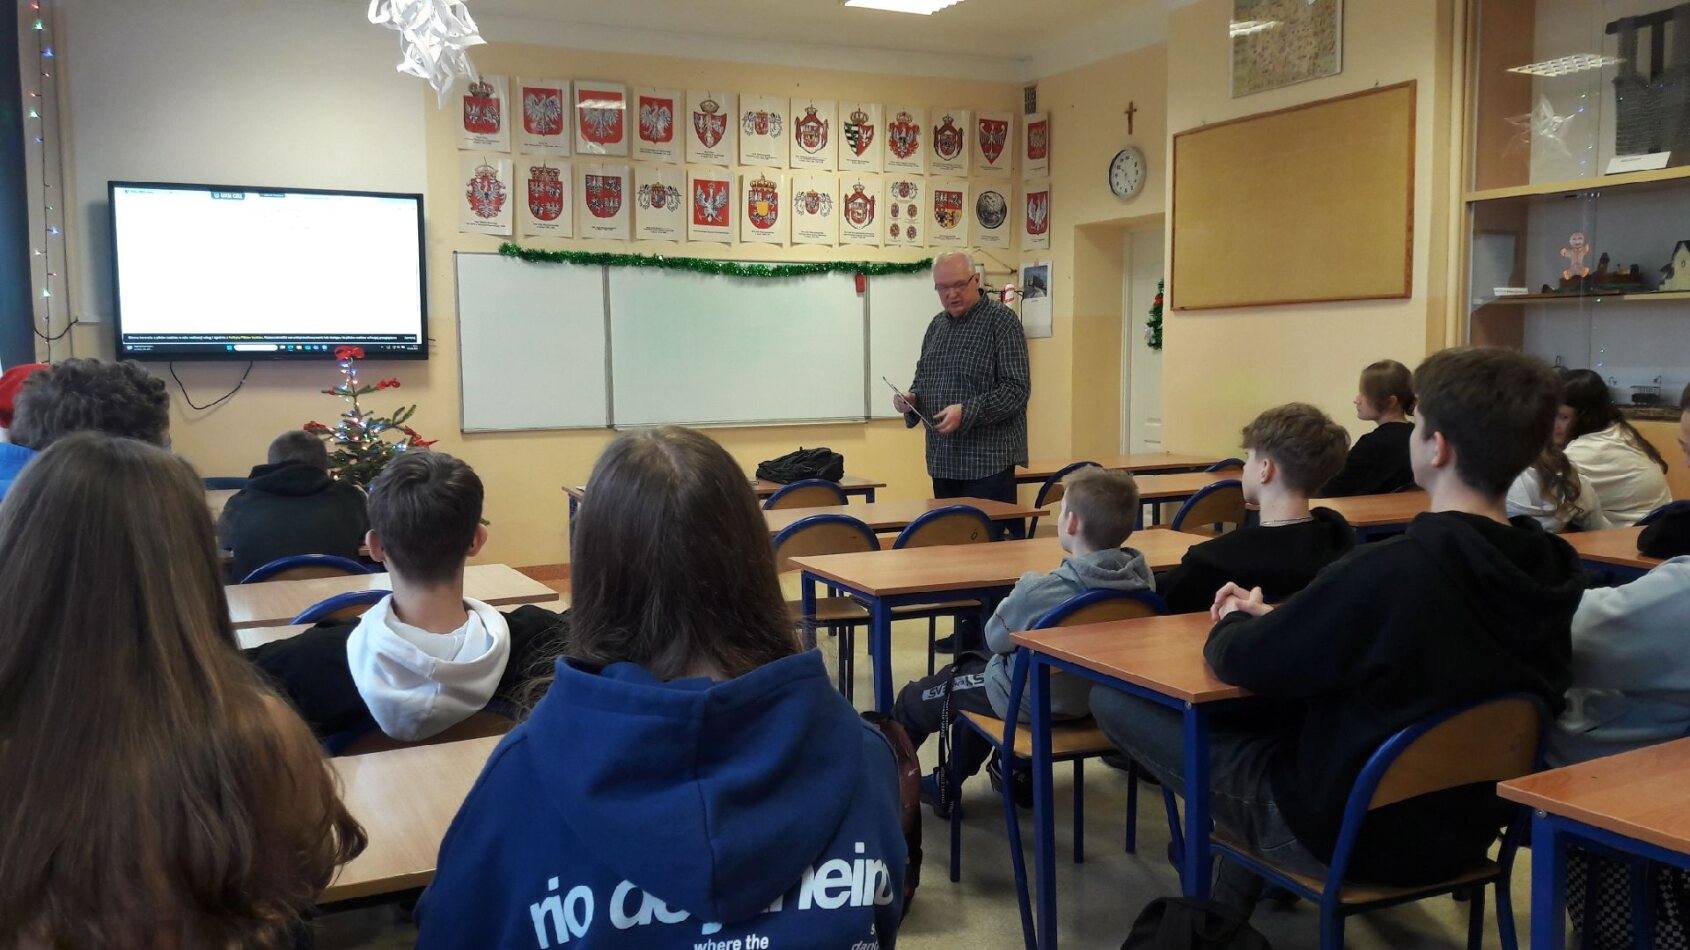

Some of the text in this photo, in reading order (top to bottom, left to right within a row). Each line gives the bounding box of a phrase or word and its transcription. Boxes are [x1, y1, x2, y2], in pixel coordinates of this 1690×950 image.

[529, 876, 595, 949] rio
[693, 938, 742, 950] where
[745, 933, 769, 950] the
